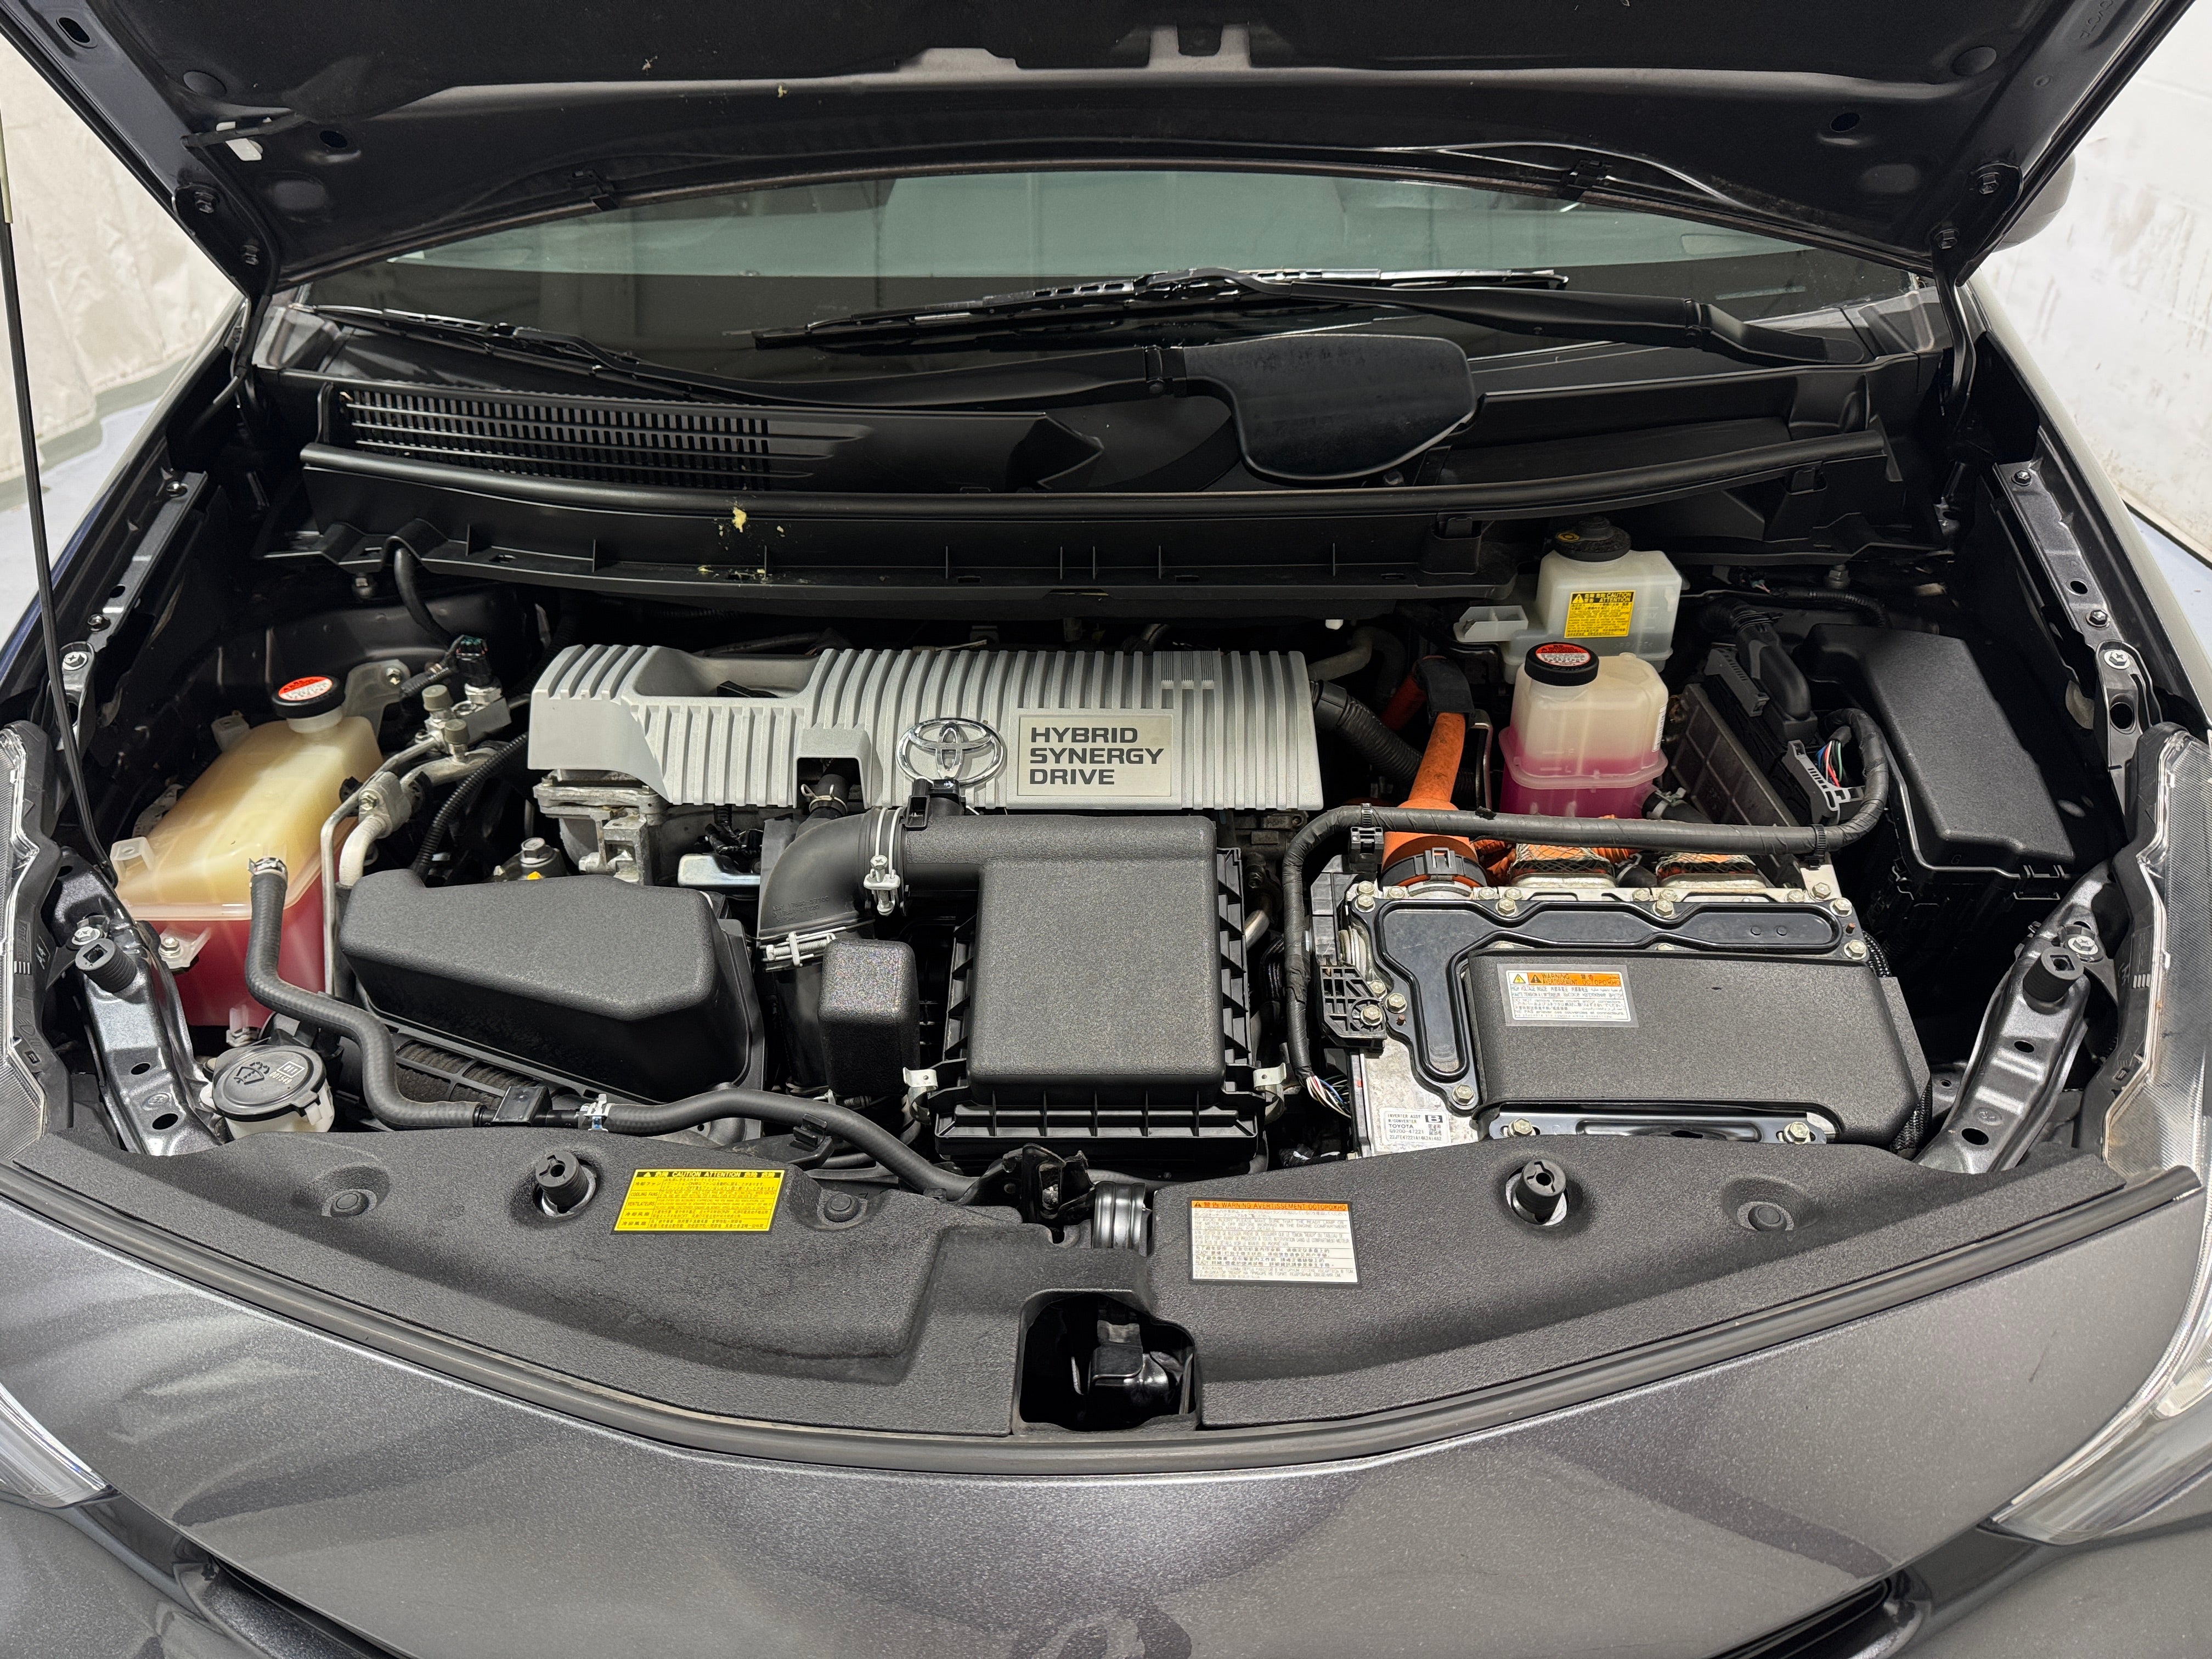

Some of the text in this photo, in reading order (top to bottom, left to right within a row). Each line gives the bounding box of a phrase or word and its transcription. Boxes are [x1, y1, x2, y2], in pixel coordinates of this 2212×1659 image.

[1030, 727, 1138, 743] HYBRID
[1030, 748, 1164, 764] SYNERGY
[1030, 769, 1115, 785] DRIVE
